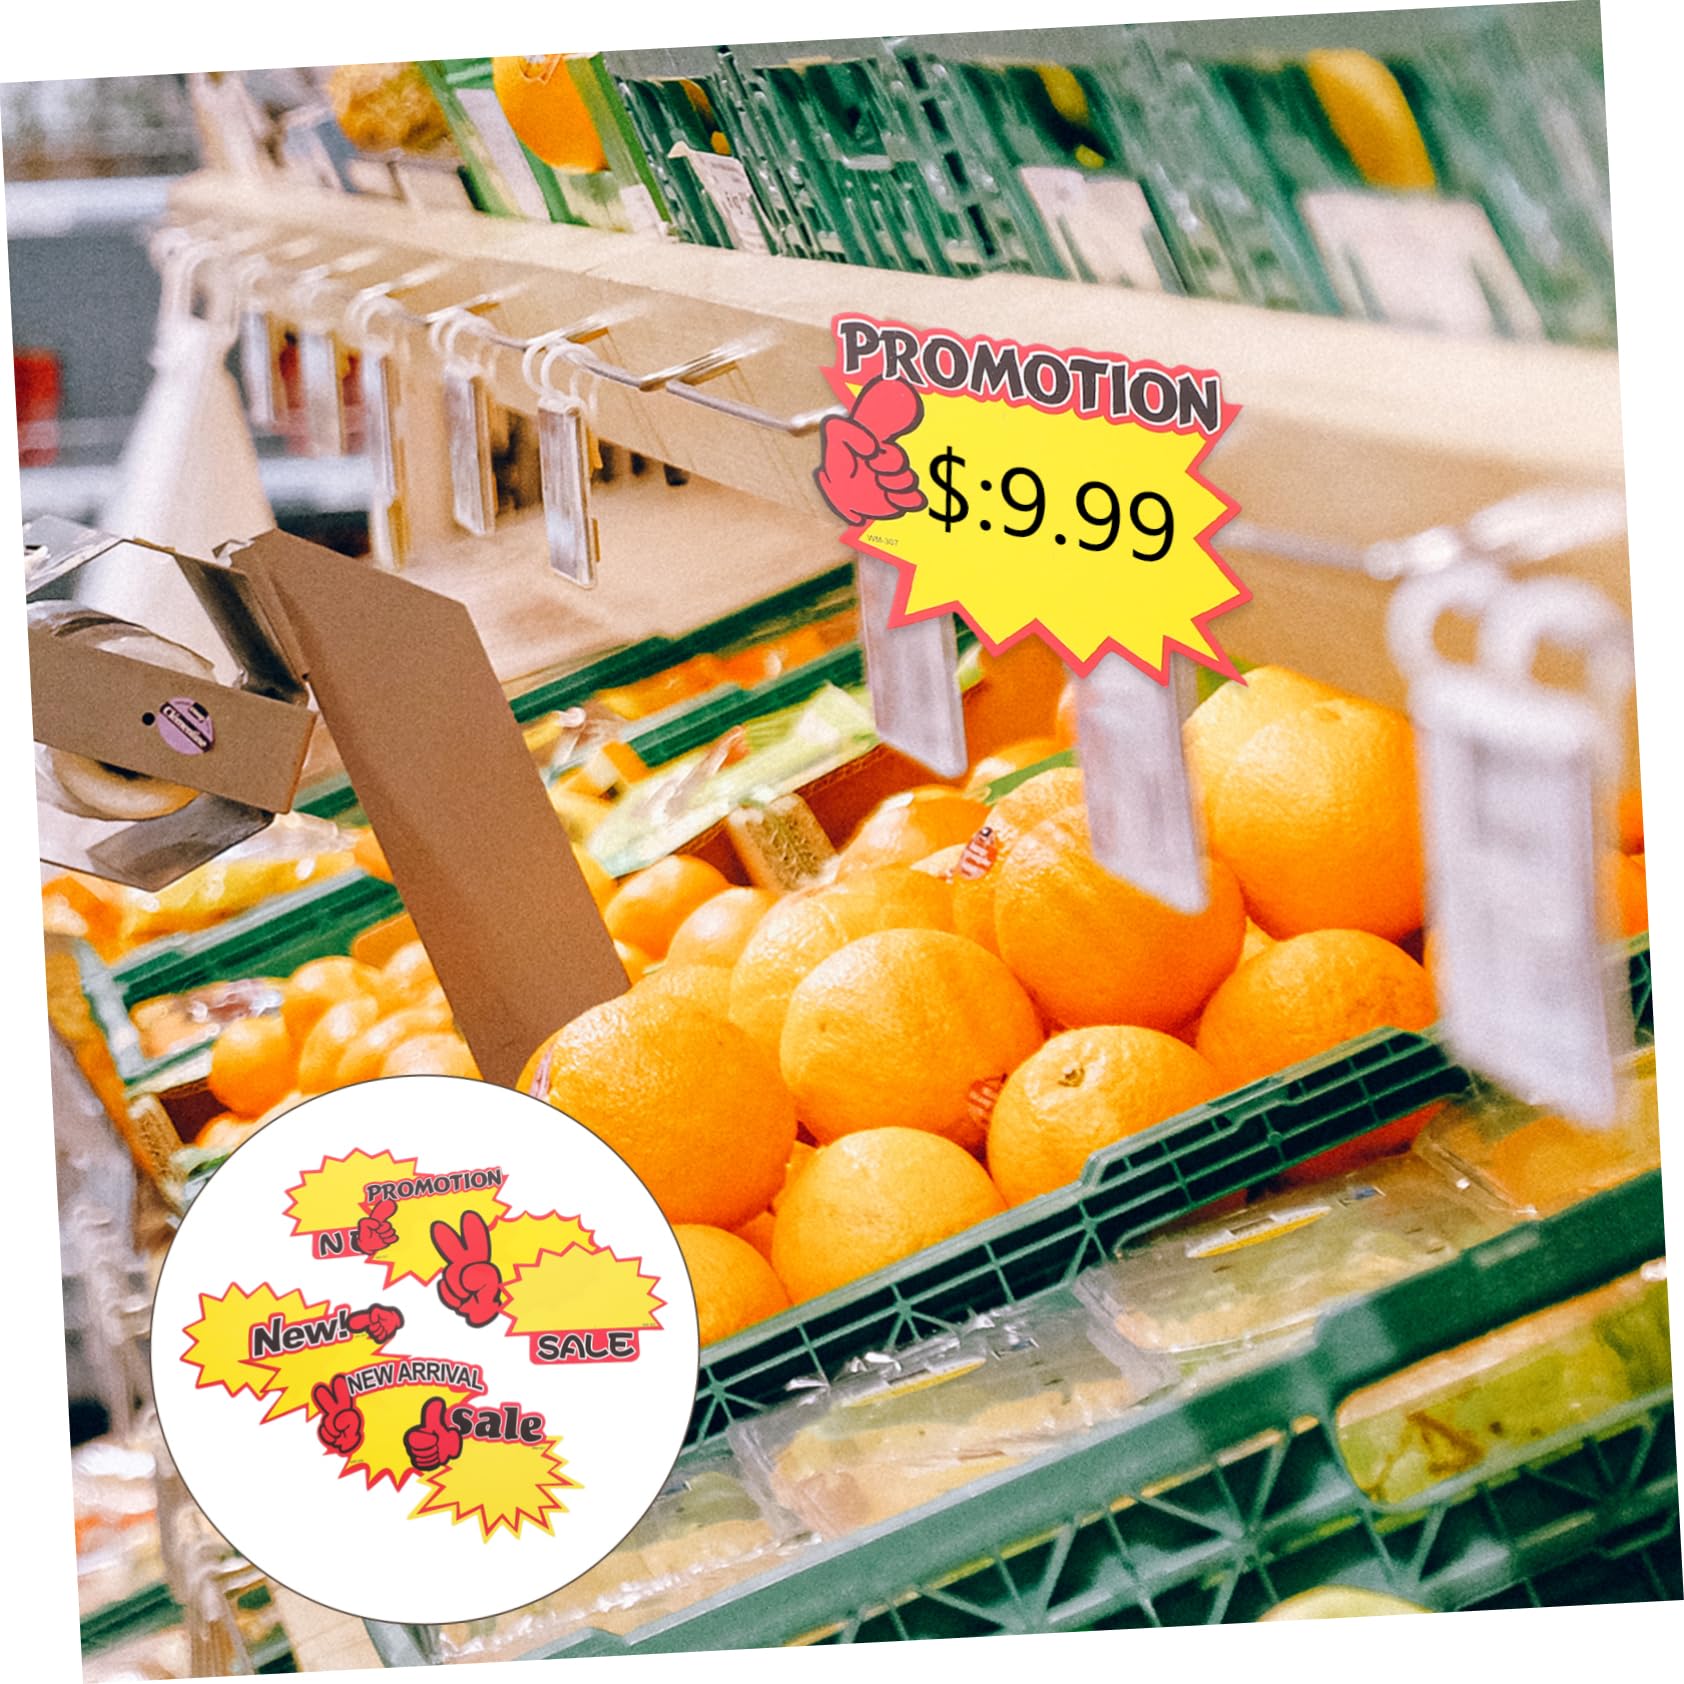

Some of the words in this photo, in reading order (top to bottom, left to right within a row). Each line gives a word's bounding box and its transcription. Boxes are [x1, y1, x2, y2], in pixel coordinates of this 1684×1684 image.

[839, 321, 1221, 431] PROMOTION
[928, 446, 1174, 562] $:9.99
[367, 1169, 501, 1202] PROMOTION
[254, 1311, 349, 1357] New!
[538, 1332, 635, 1361] SALE
[347, 1365, 395, 1395] NEW
[398, 1361, 484, 1391] ARRIVAL
[451, 1407, 543, 1441] sale
